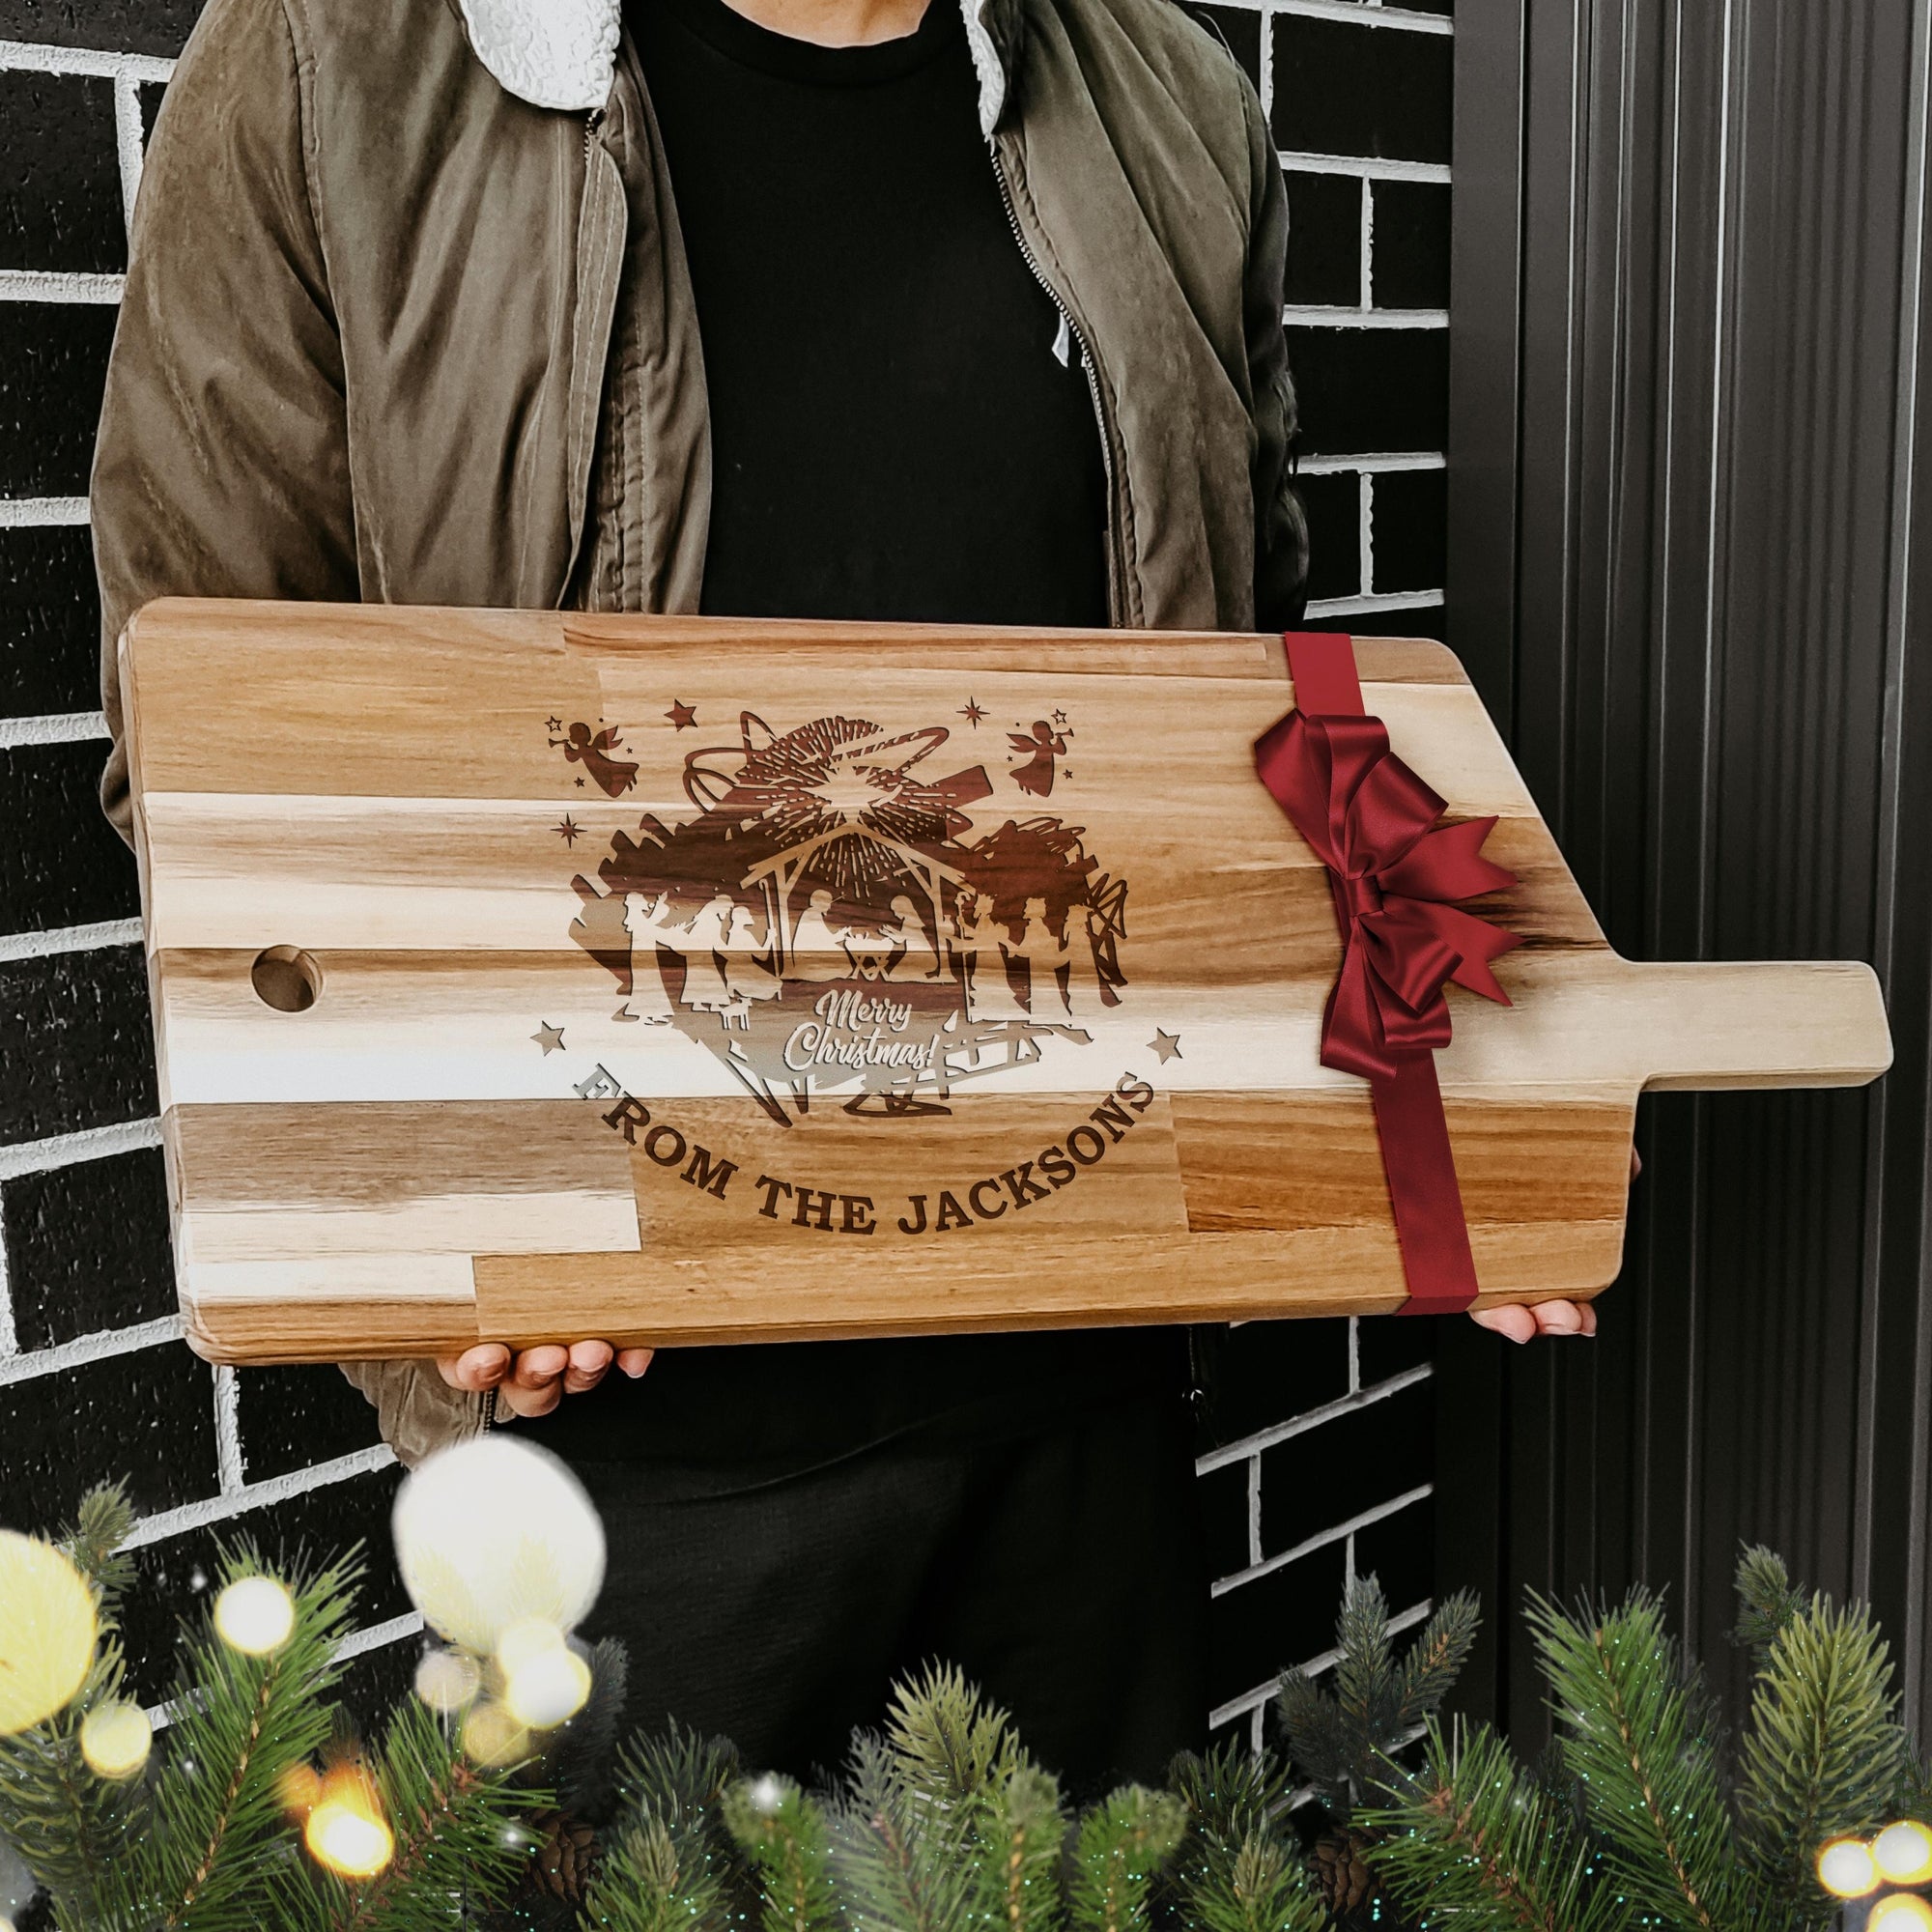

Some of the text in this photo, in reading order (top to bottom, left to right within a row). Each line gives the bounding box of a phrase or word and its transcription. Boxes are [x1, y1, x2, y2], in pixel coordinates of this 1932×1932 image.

[814, 989, 912, 1032] Merry
[783, 1021, 940, 1071] Christmas!
[572, 1063, 1154, 1236] FROM THE JACKSONS
